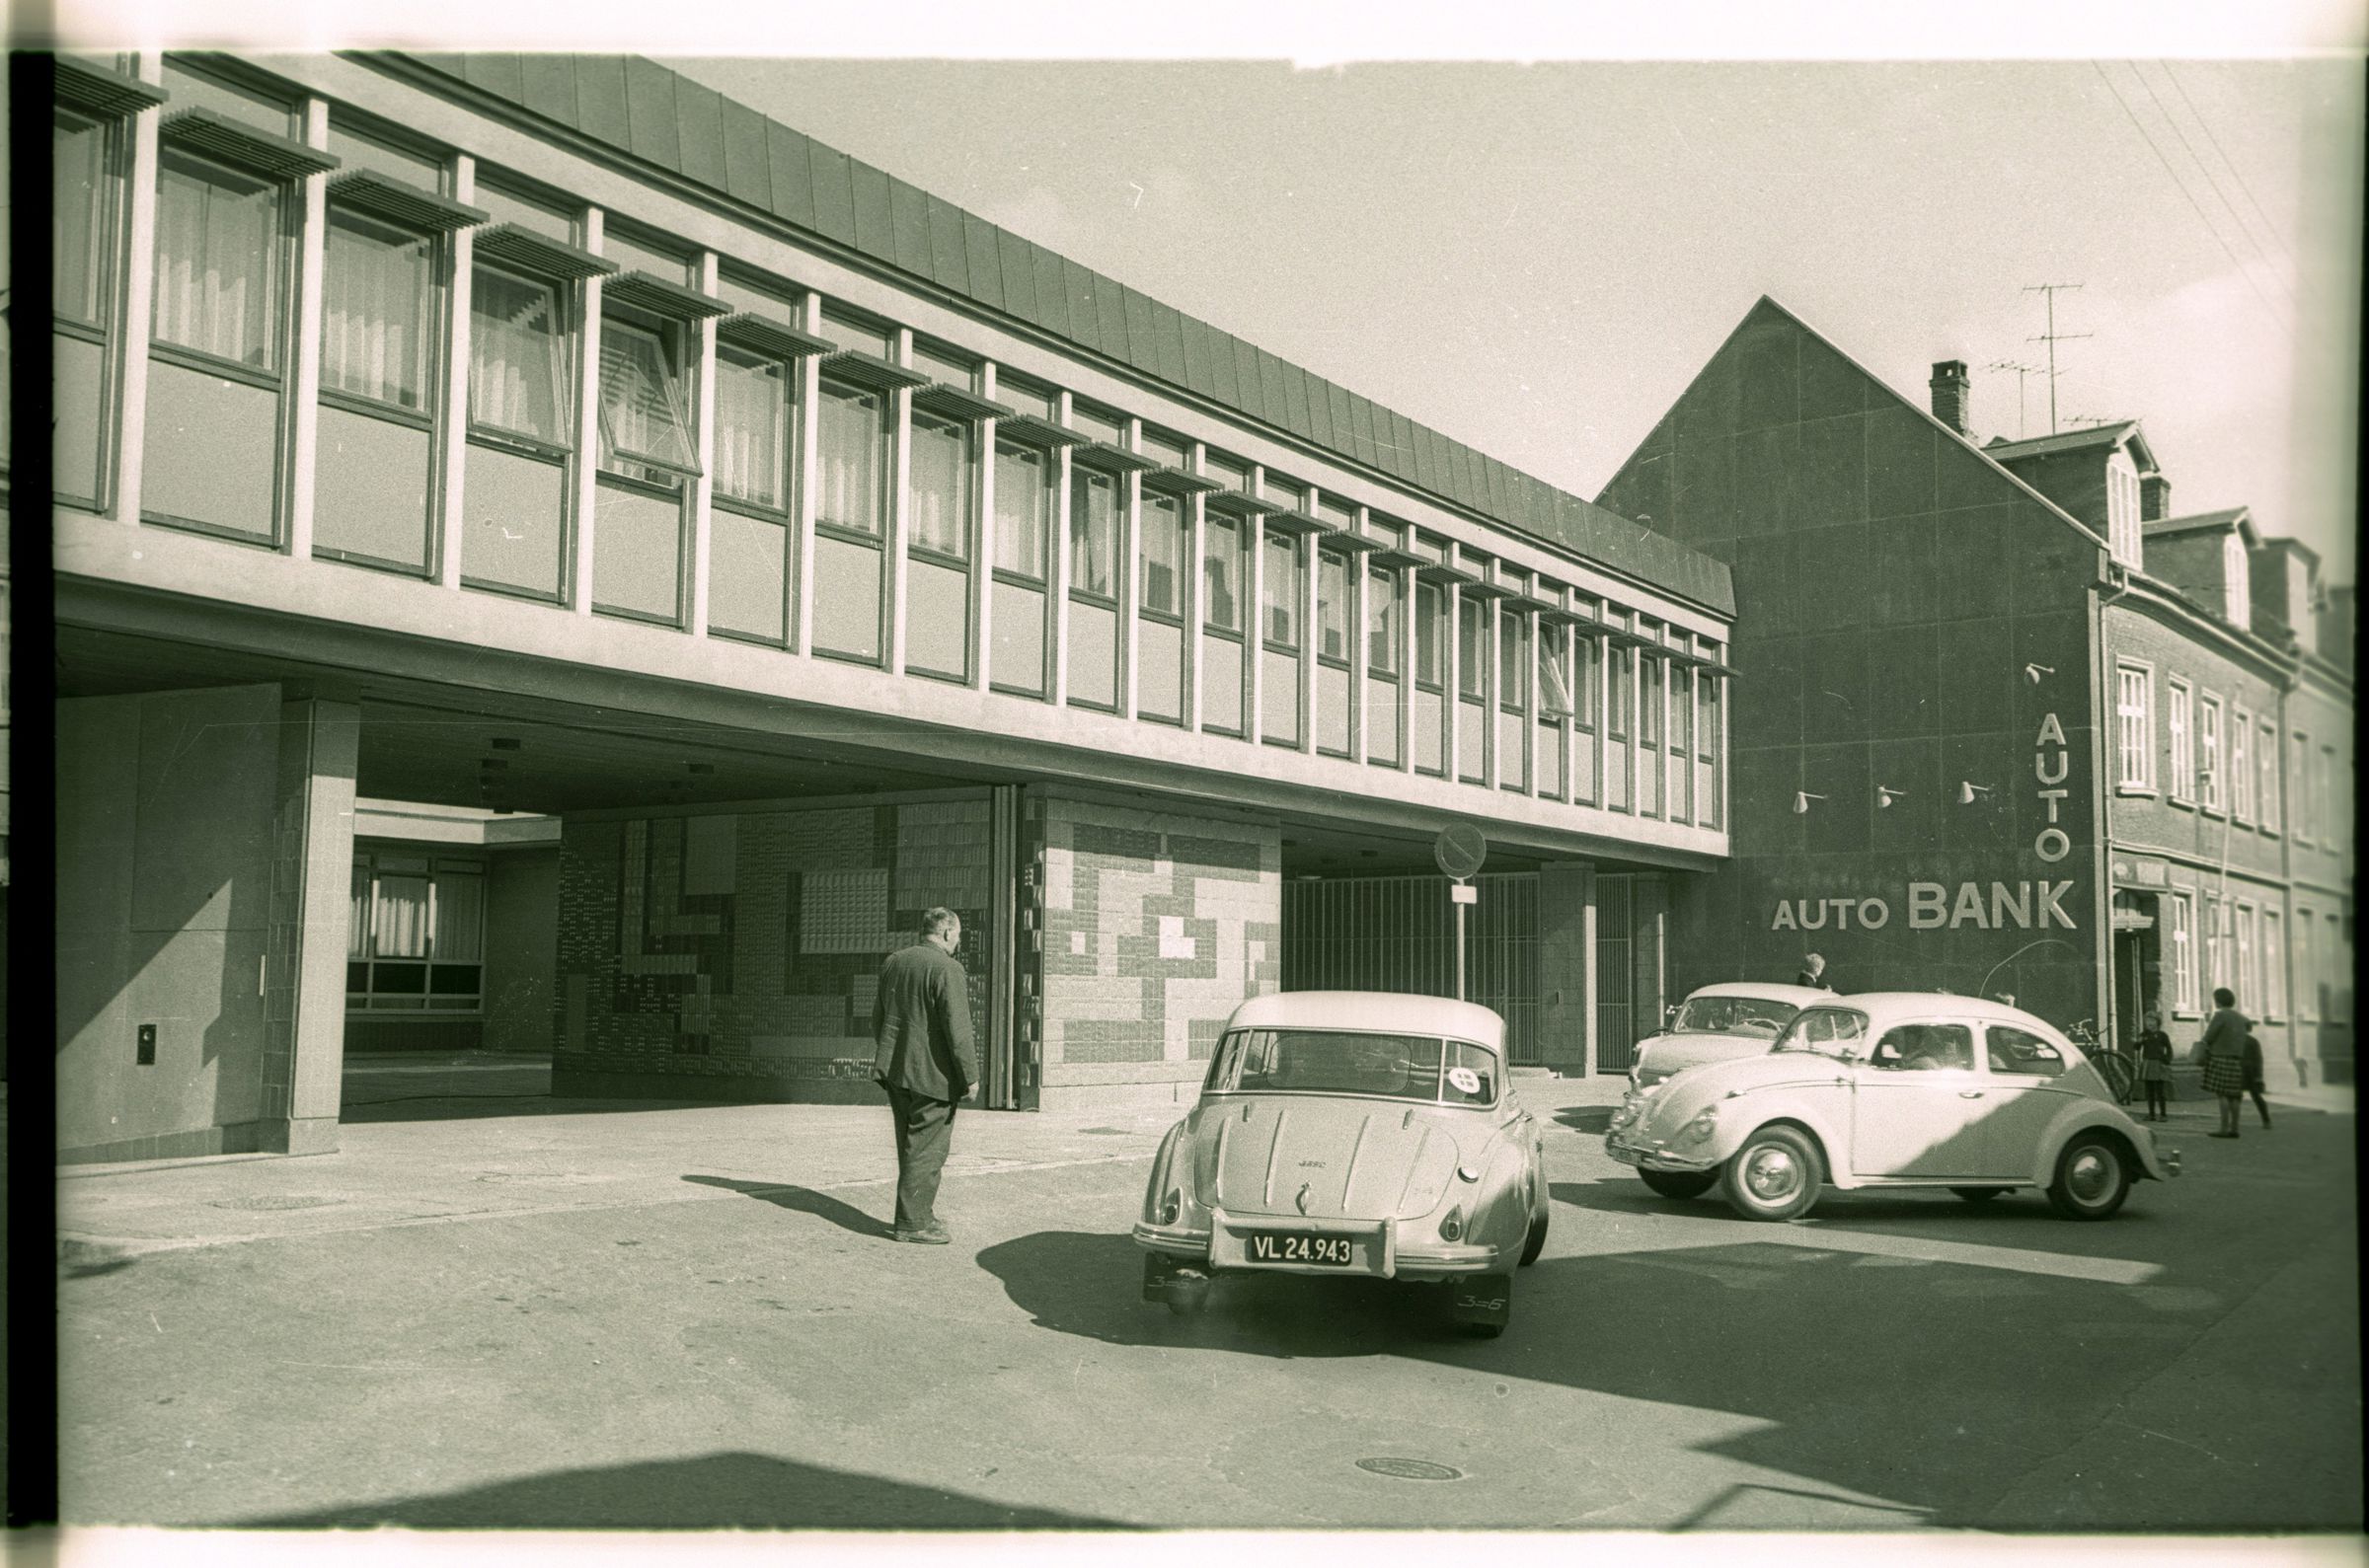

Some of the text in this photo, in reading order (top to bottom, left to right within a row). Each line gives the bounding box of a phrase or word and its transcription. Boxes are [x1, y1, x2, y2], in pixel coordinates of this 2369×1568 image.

[2034, 712, 2070, 862] AUTO
[1771, 879, 2077, 931] AUTO BANK
[1254, 1235, 1350, 1262] VL 24.943
[1457, 1295, 1506, 1310] 3=6
